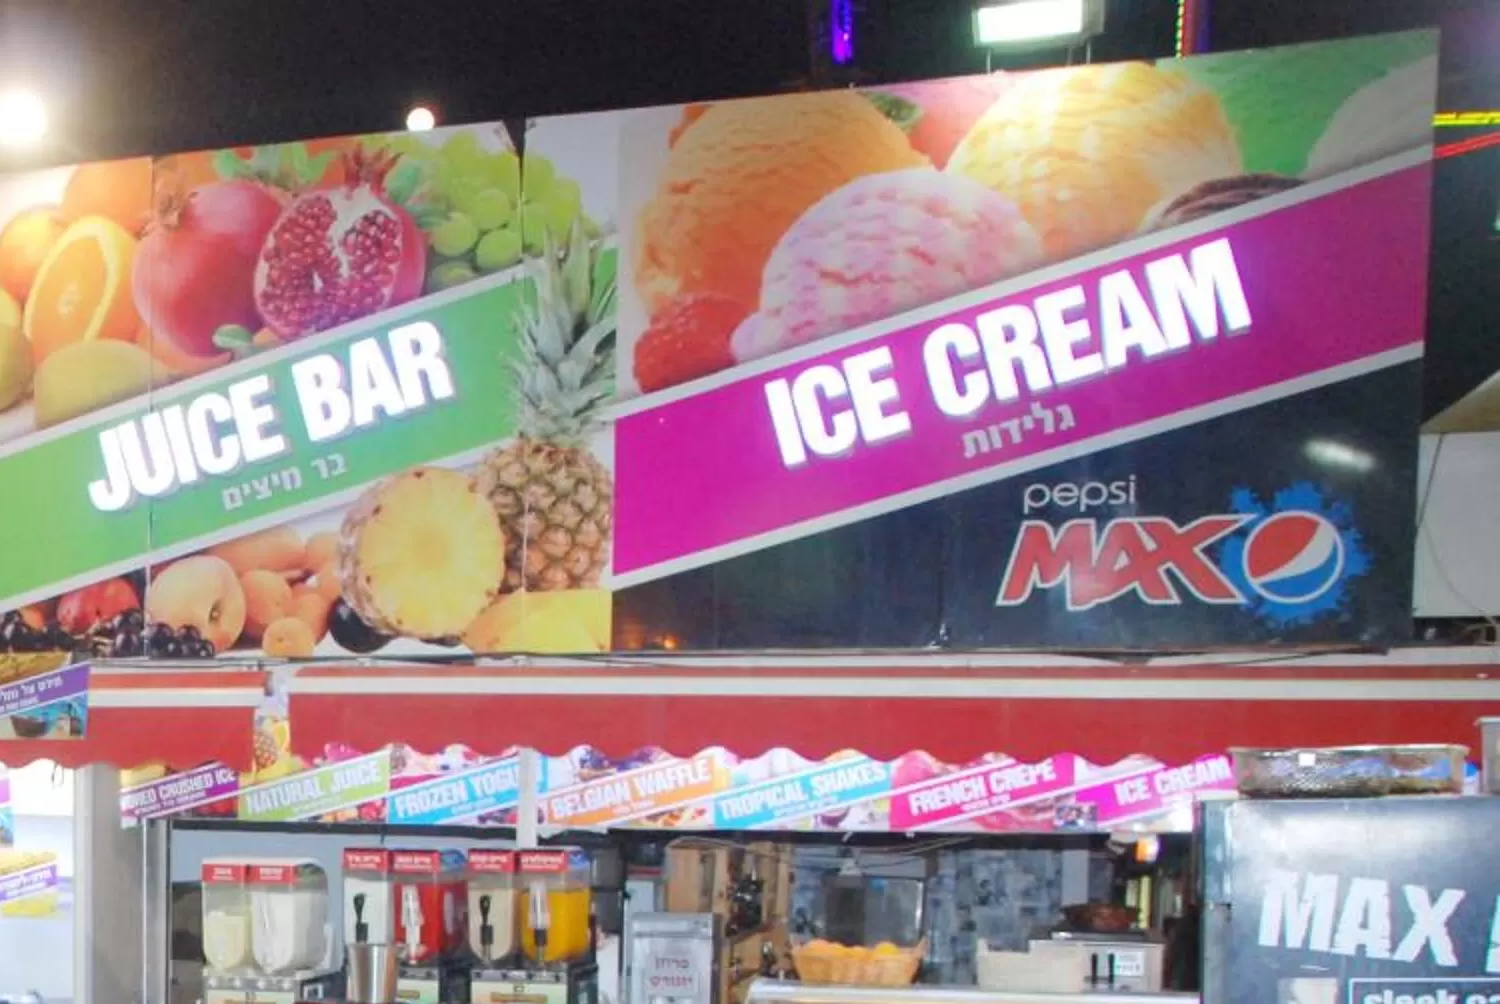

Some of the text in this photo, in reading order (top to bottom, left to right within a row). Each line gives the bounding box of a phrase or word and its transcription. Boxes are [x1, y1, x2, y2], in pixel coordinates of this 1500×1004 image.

[763, 236, 1252, 468] ICE CREAM
[87, 320, 456, 512] JUICE BAR
[961, 398, 1077, 460] גלידות
[222, 451, 347, 511] בר מיצים
[1023, 474, 1137, 514] pepsi
[995, 514, 1262, 611] MAX
[246, 775, 324, 815] NATURAL
[331, 760, 382, 793] JUICE
[394, 778, 469, 818] FROZEN
[551, 780, 630, 820] BELGIAN
[632, 759, 711, 798] WAFFLE
[720, 780, 809, 821] TROPICAL
[810, 763, 887, 798] SHAKES
[908, 775, 988, 816] FRENCH
[989, 758, 1057, 794] CREPE
[1113, 755, 1232, 806] ICE CREAM
[1257, 870, 1466, 967] MAX
